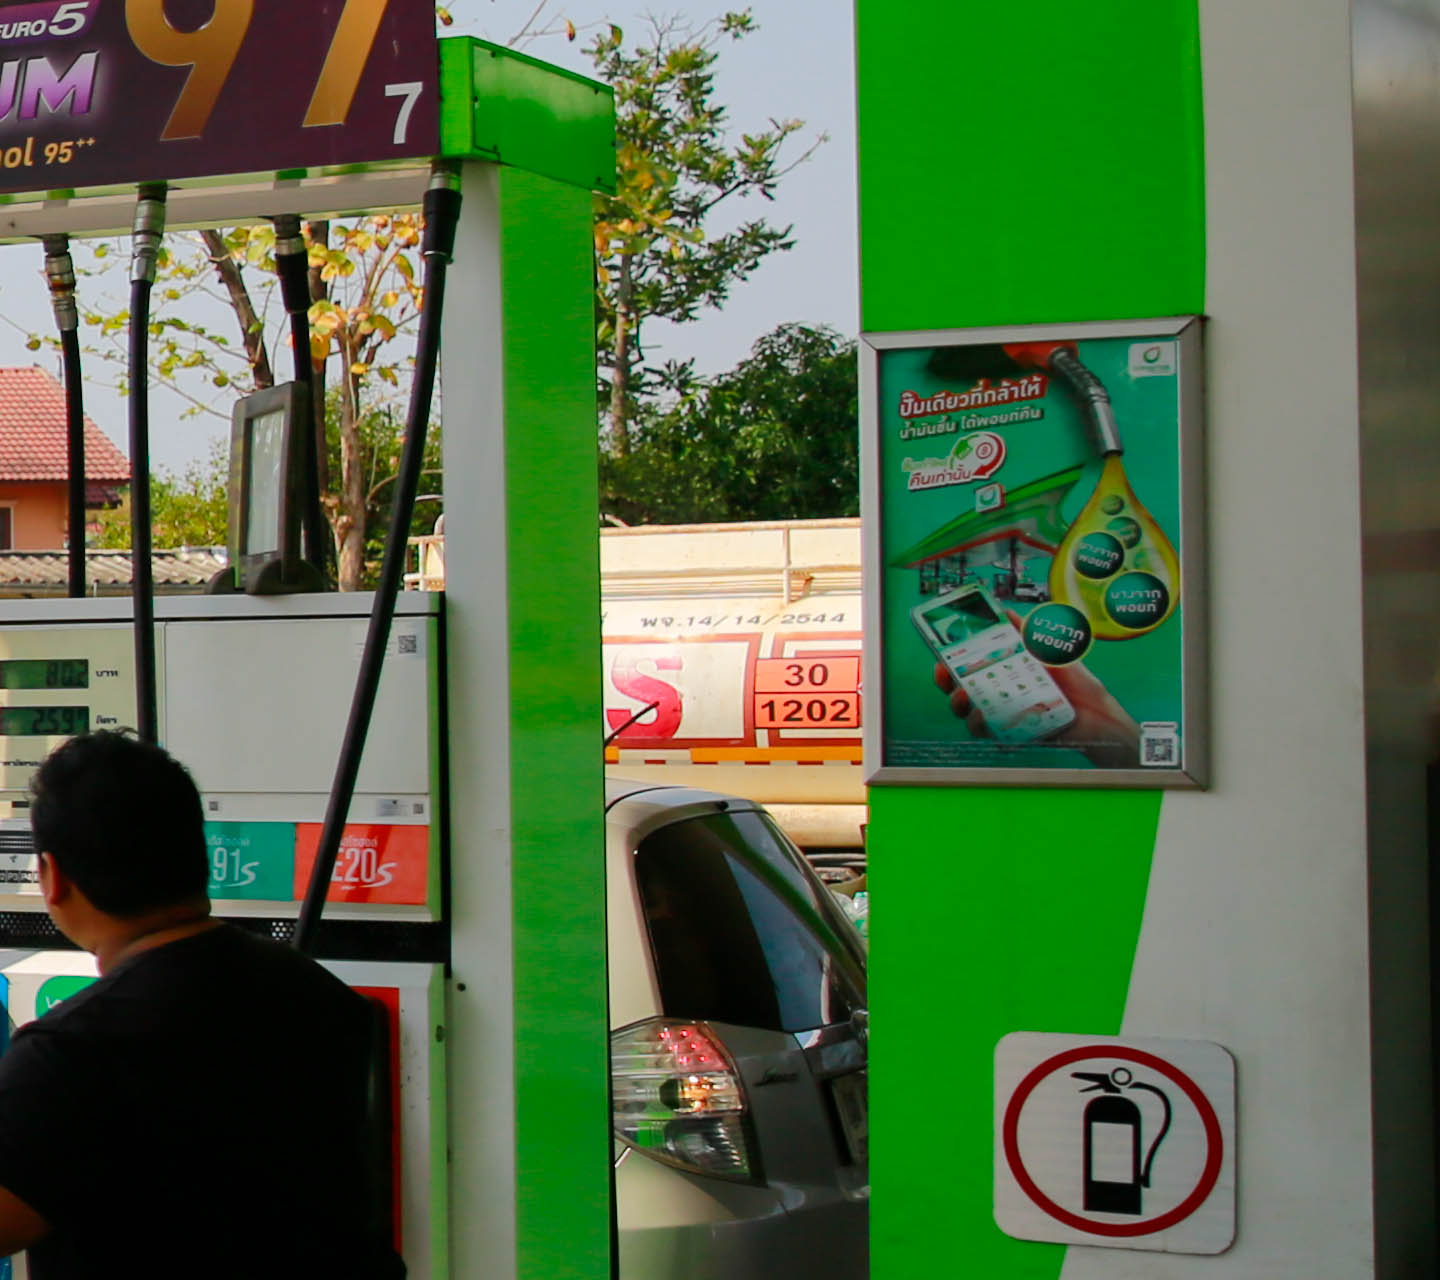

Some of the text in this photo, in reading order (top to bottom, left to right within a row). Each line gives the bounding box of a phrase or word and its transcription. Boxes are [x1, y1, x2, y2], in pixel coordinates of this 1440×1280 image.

[48, 0, 91, 38] 5
[383, 82, 424, 145] 7
[784, 663, 829, 686] 30
[760, 699, 852, 723] 1202
